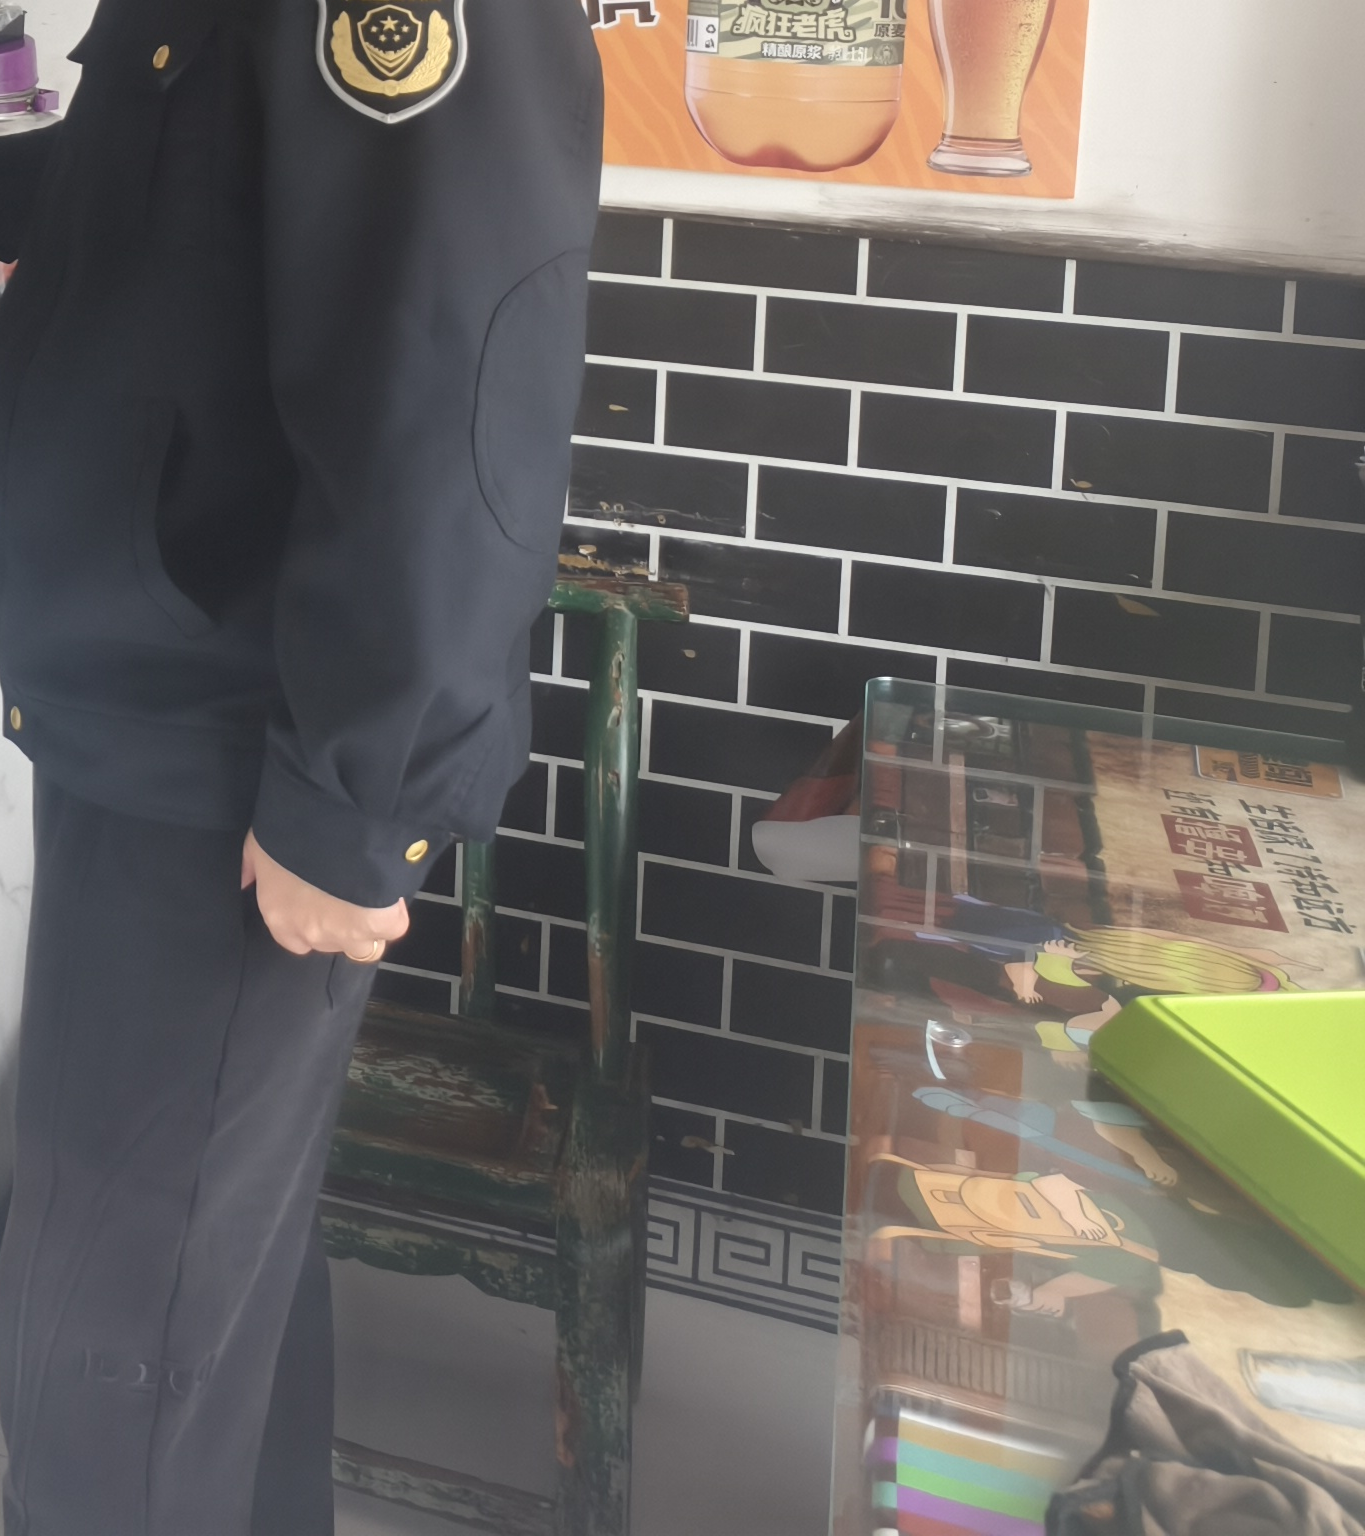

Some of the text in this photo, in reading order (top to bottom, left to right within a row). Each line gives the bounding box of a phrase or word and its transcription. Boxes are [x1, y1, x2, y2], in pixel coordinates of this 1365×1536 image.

[730, 2, 858, 44] 疯狂老虎
[761, 40, 823, 61] 精酿原浆
